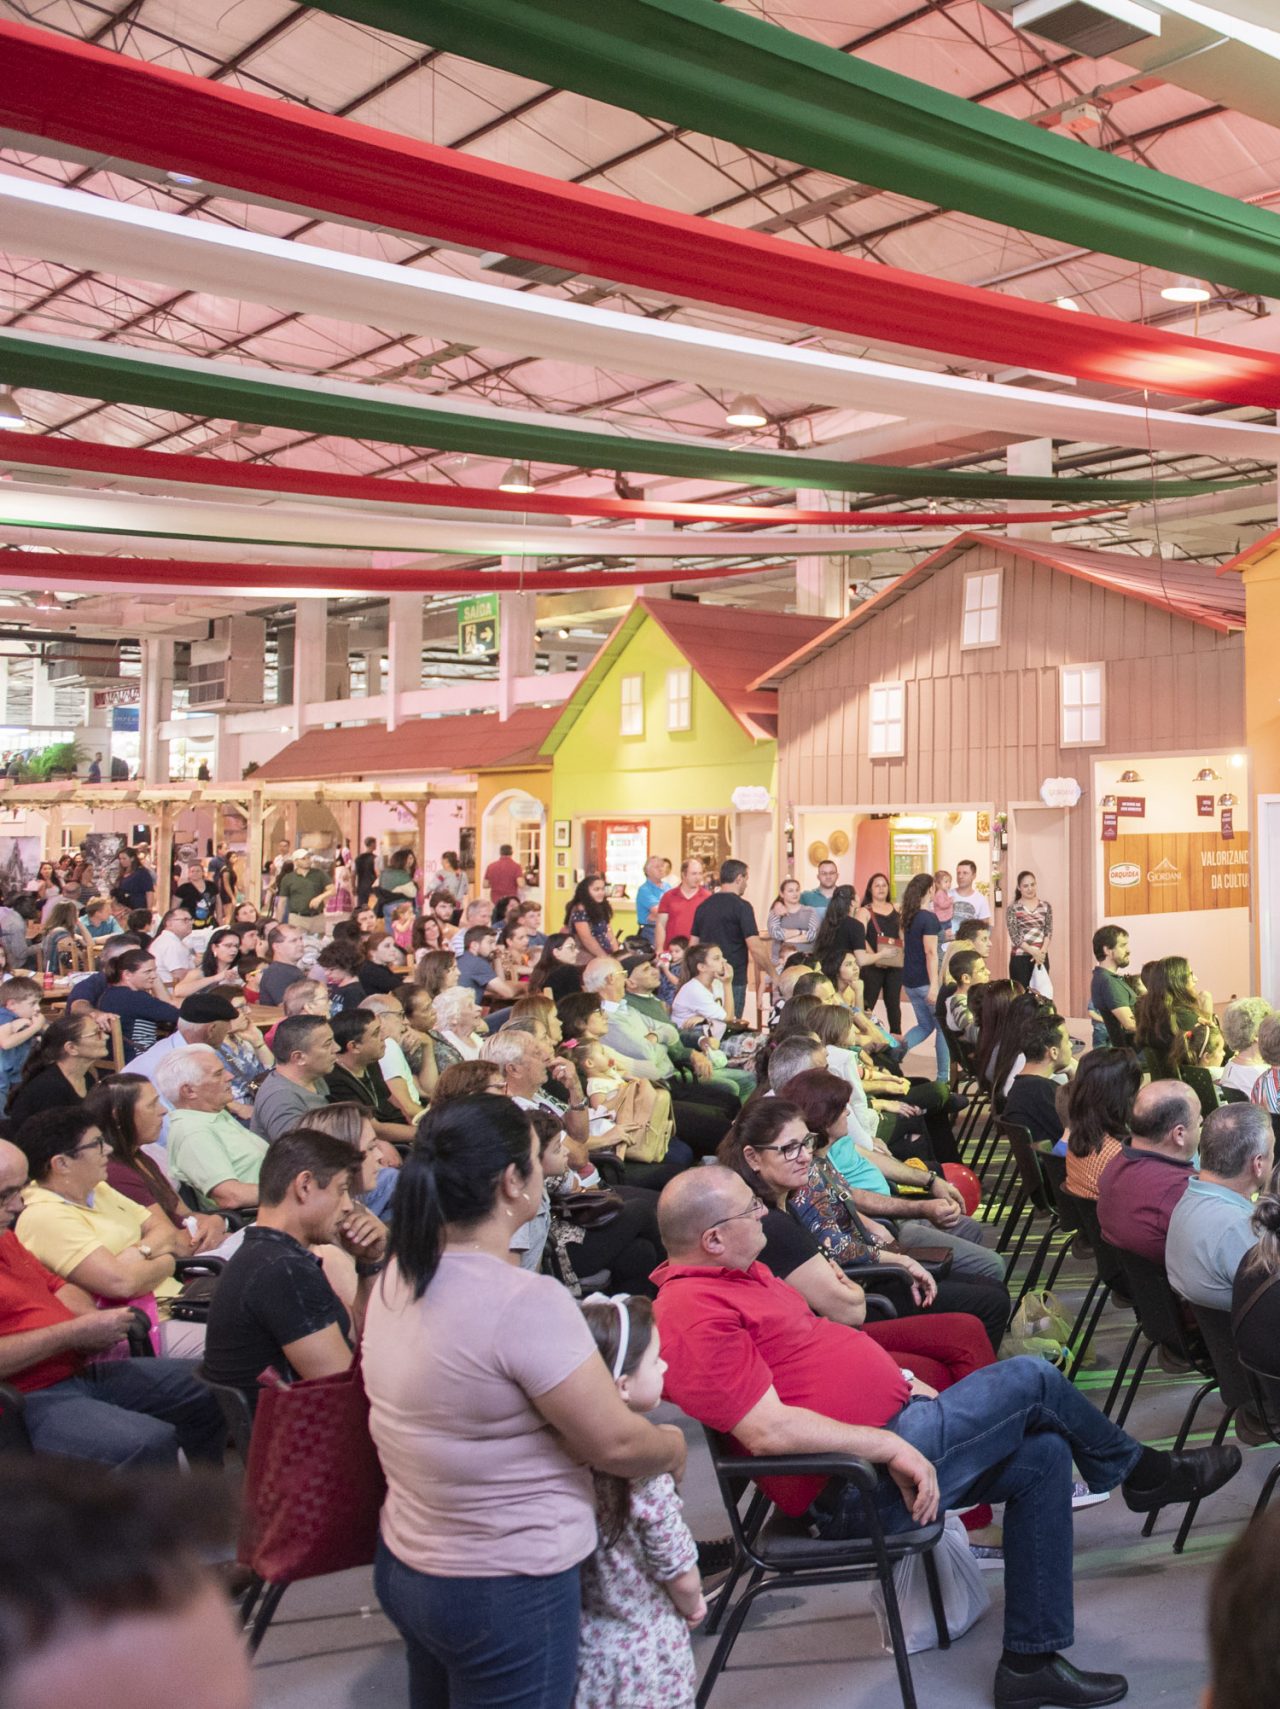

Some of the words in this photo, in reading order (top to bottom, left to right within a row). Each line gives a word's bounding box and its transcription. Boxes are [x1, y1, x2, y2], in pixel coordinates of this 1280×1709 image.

[463, 601, 493, 620] SAÍDA
[1211, 873, 1223, 889] DA
[1223, 872, 1249, 889] CULTU
